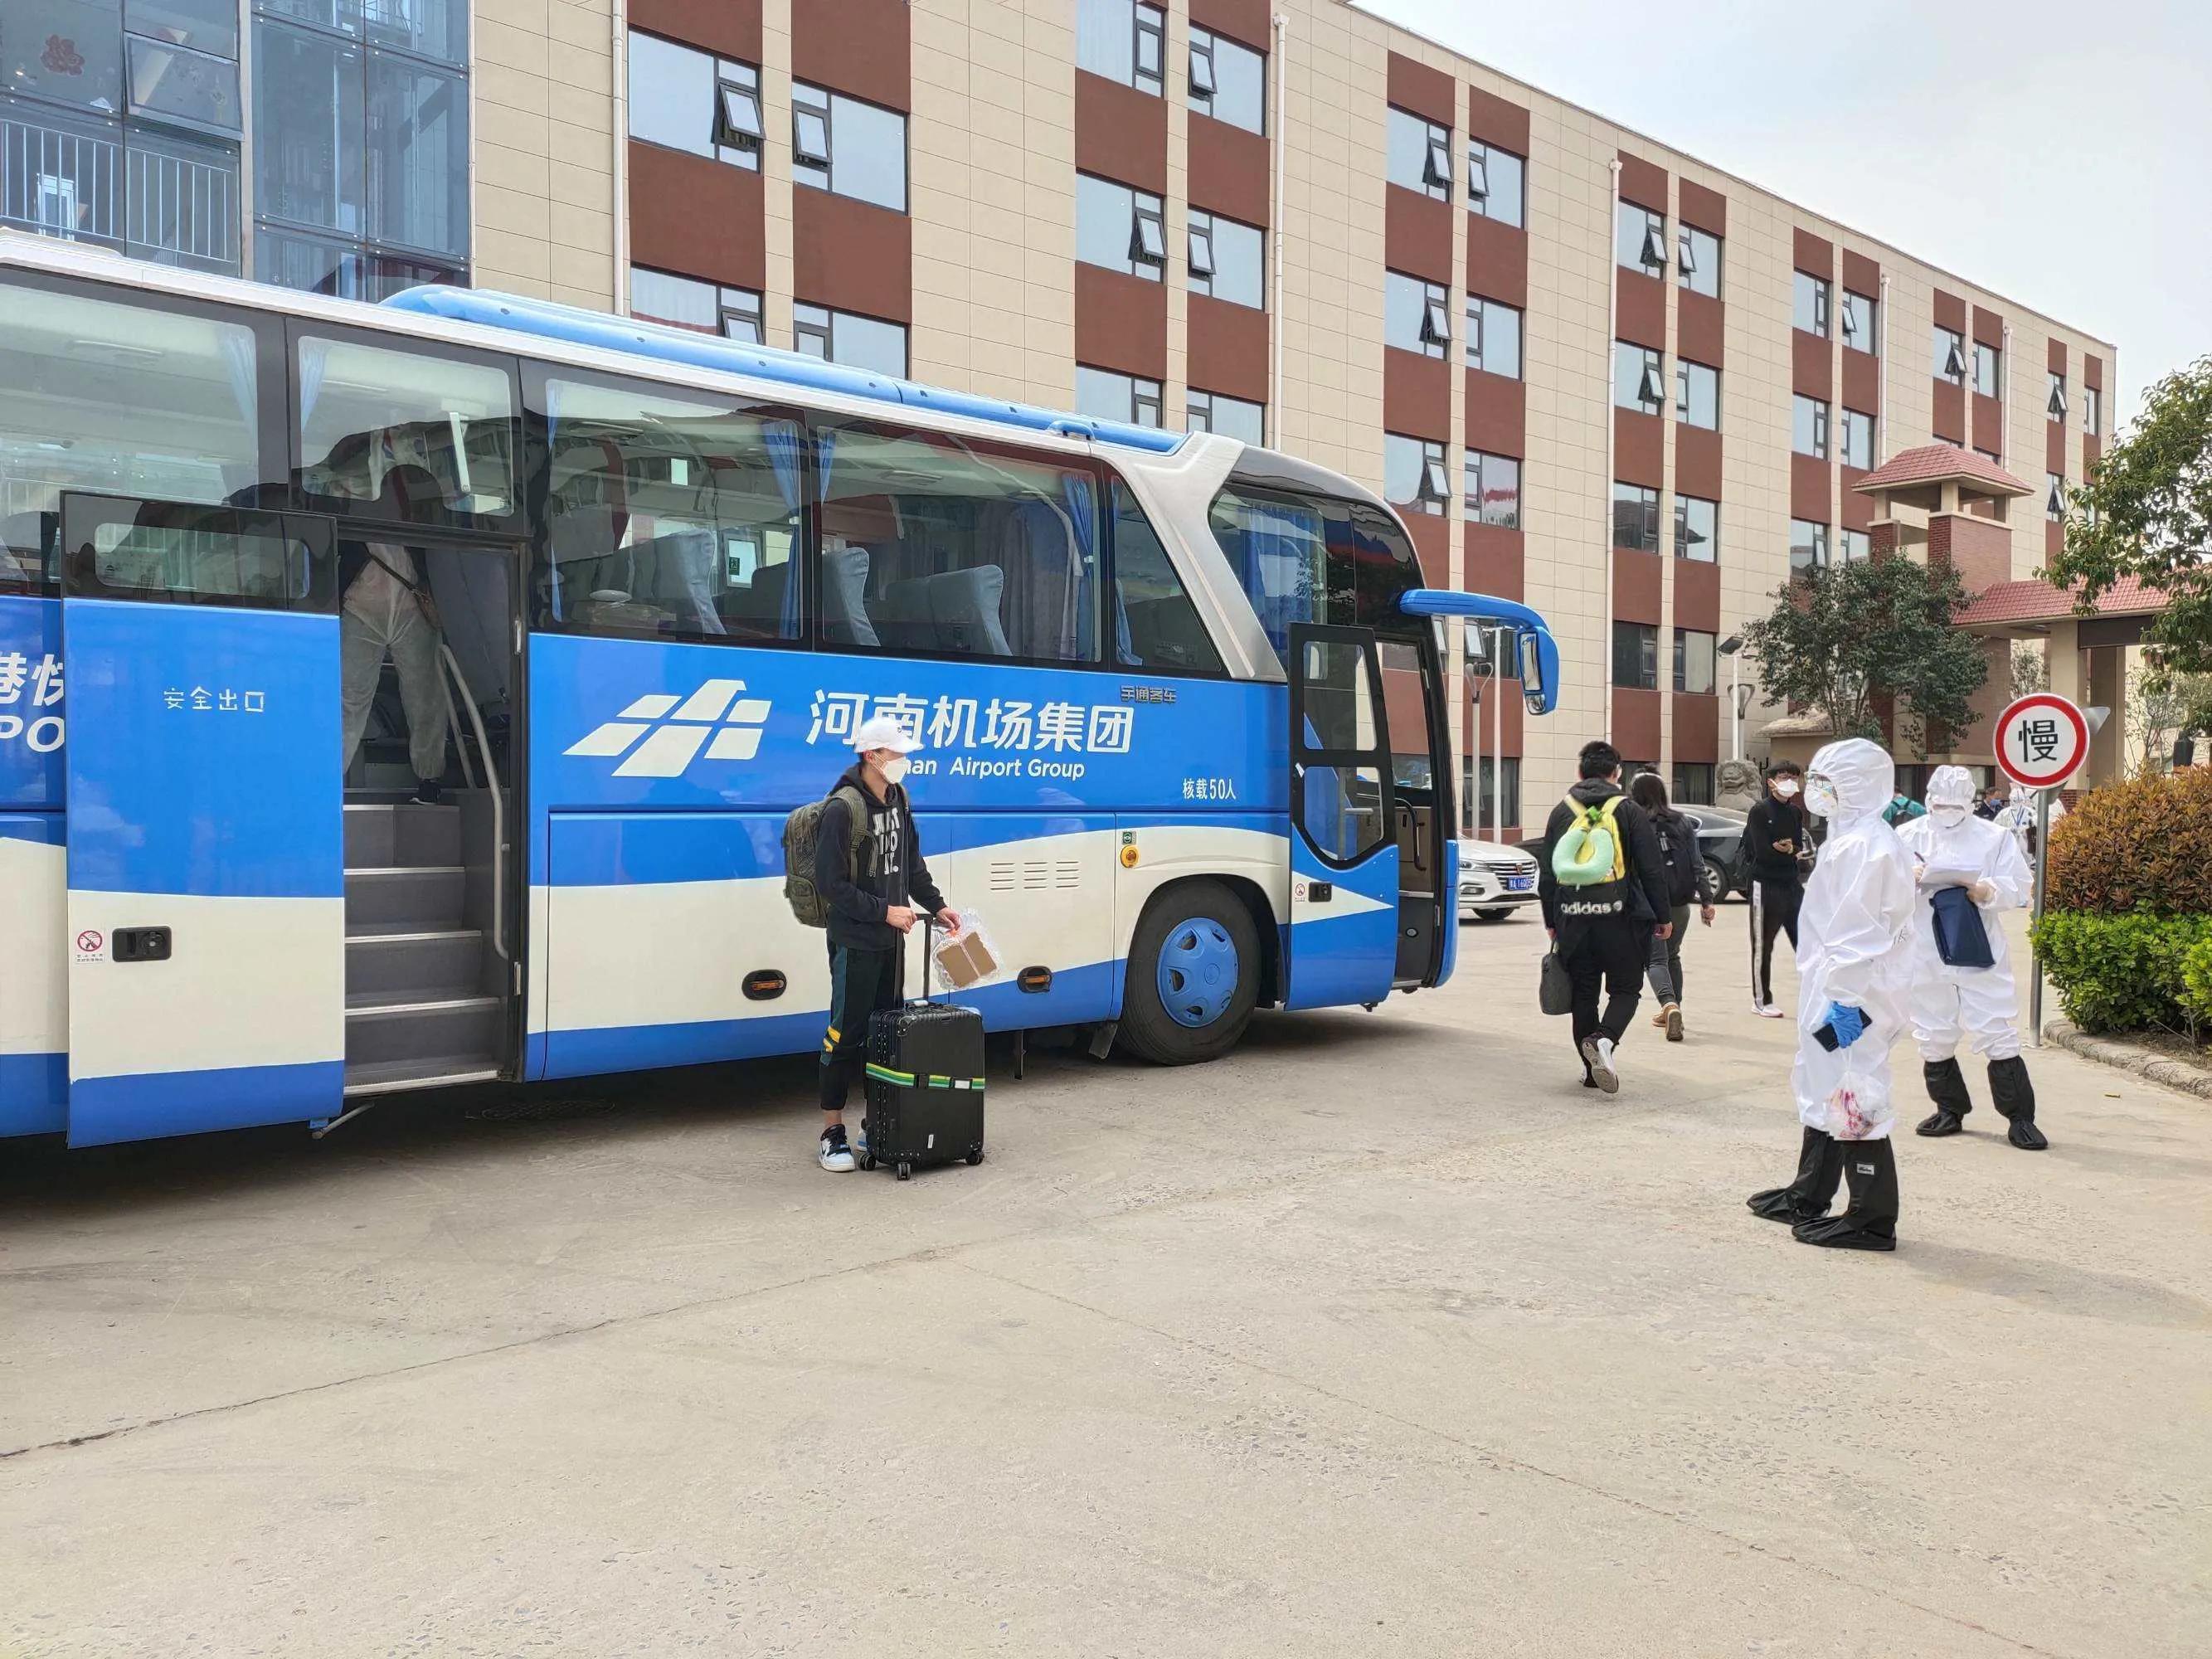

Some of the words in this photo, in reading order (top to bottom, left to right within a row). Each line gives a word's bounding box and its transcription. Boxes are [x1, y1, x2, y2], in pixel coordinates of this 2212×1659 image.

[163, 686, 265, 713] 安全出口
[806, 689, 1135, 753] 河南机场集团
[2018, 719, 2059, 763] 慢
[903, 757, 937, 775] nan
[949, 756, 1022, 780] Airport
[1028, 758, 1085, 781] Group
[1183, 777, 1237, 800] 核载50人
[1560, 901, 1612, 915] adidas
